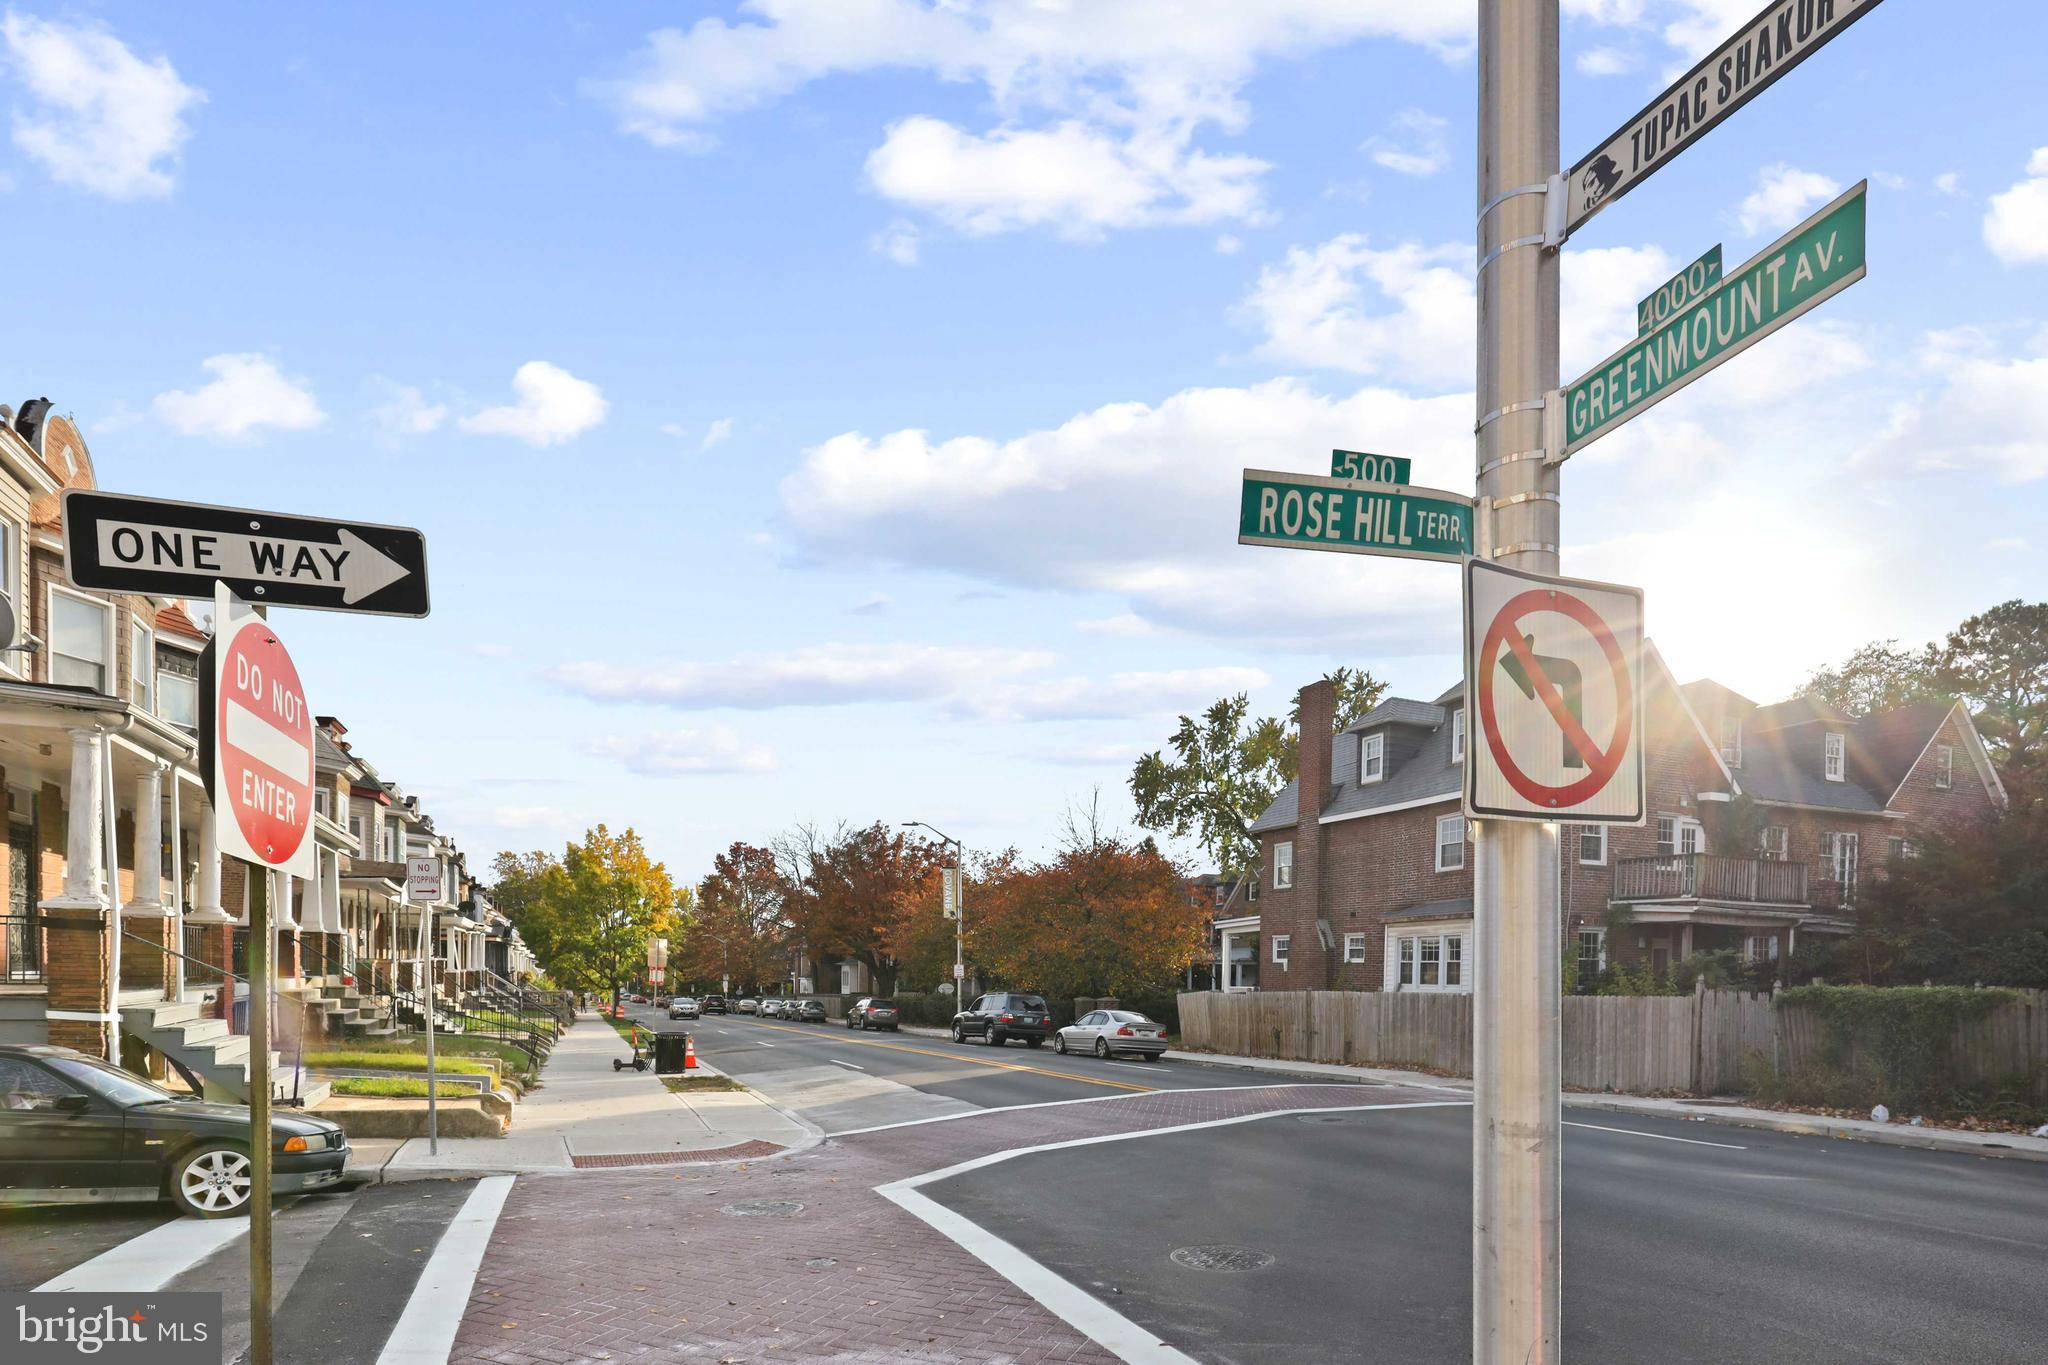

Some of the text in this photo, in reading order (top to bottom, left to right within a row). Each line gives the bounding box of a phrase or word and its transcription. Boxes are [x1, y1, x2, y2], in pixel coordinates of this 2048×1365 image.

[1631, 76, 1708, 174] TUPAC
[1639, 261, 1706, 329] 4000
[1572, 231, 1844, 435] GREENMOUNT AV.
[1344, 452, 1397, 485] 500
[1259, 487, 1465, 545] ROSE HILL TERR.
[111, 527, 351, 582] ONE WAY
[237, 651, 303, 729] DO NOT
[242, 768, 296, 826] ENTER
[410, 876, 439, 884] STOPPING
[417, 863, 430, 872] NO
